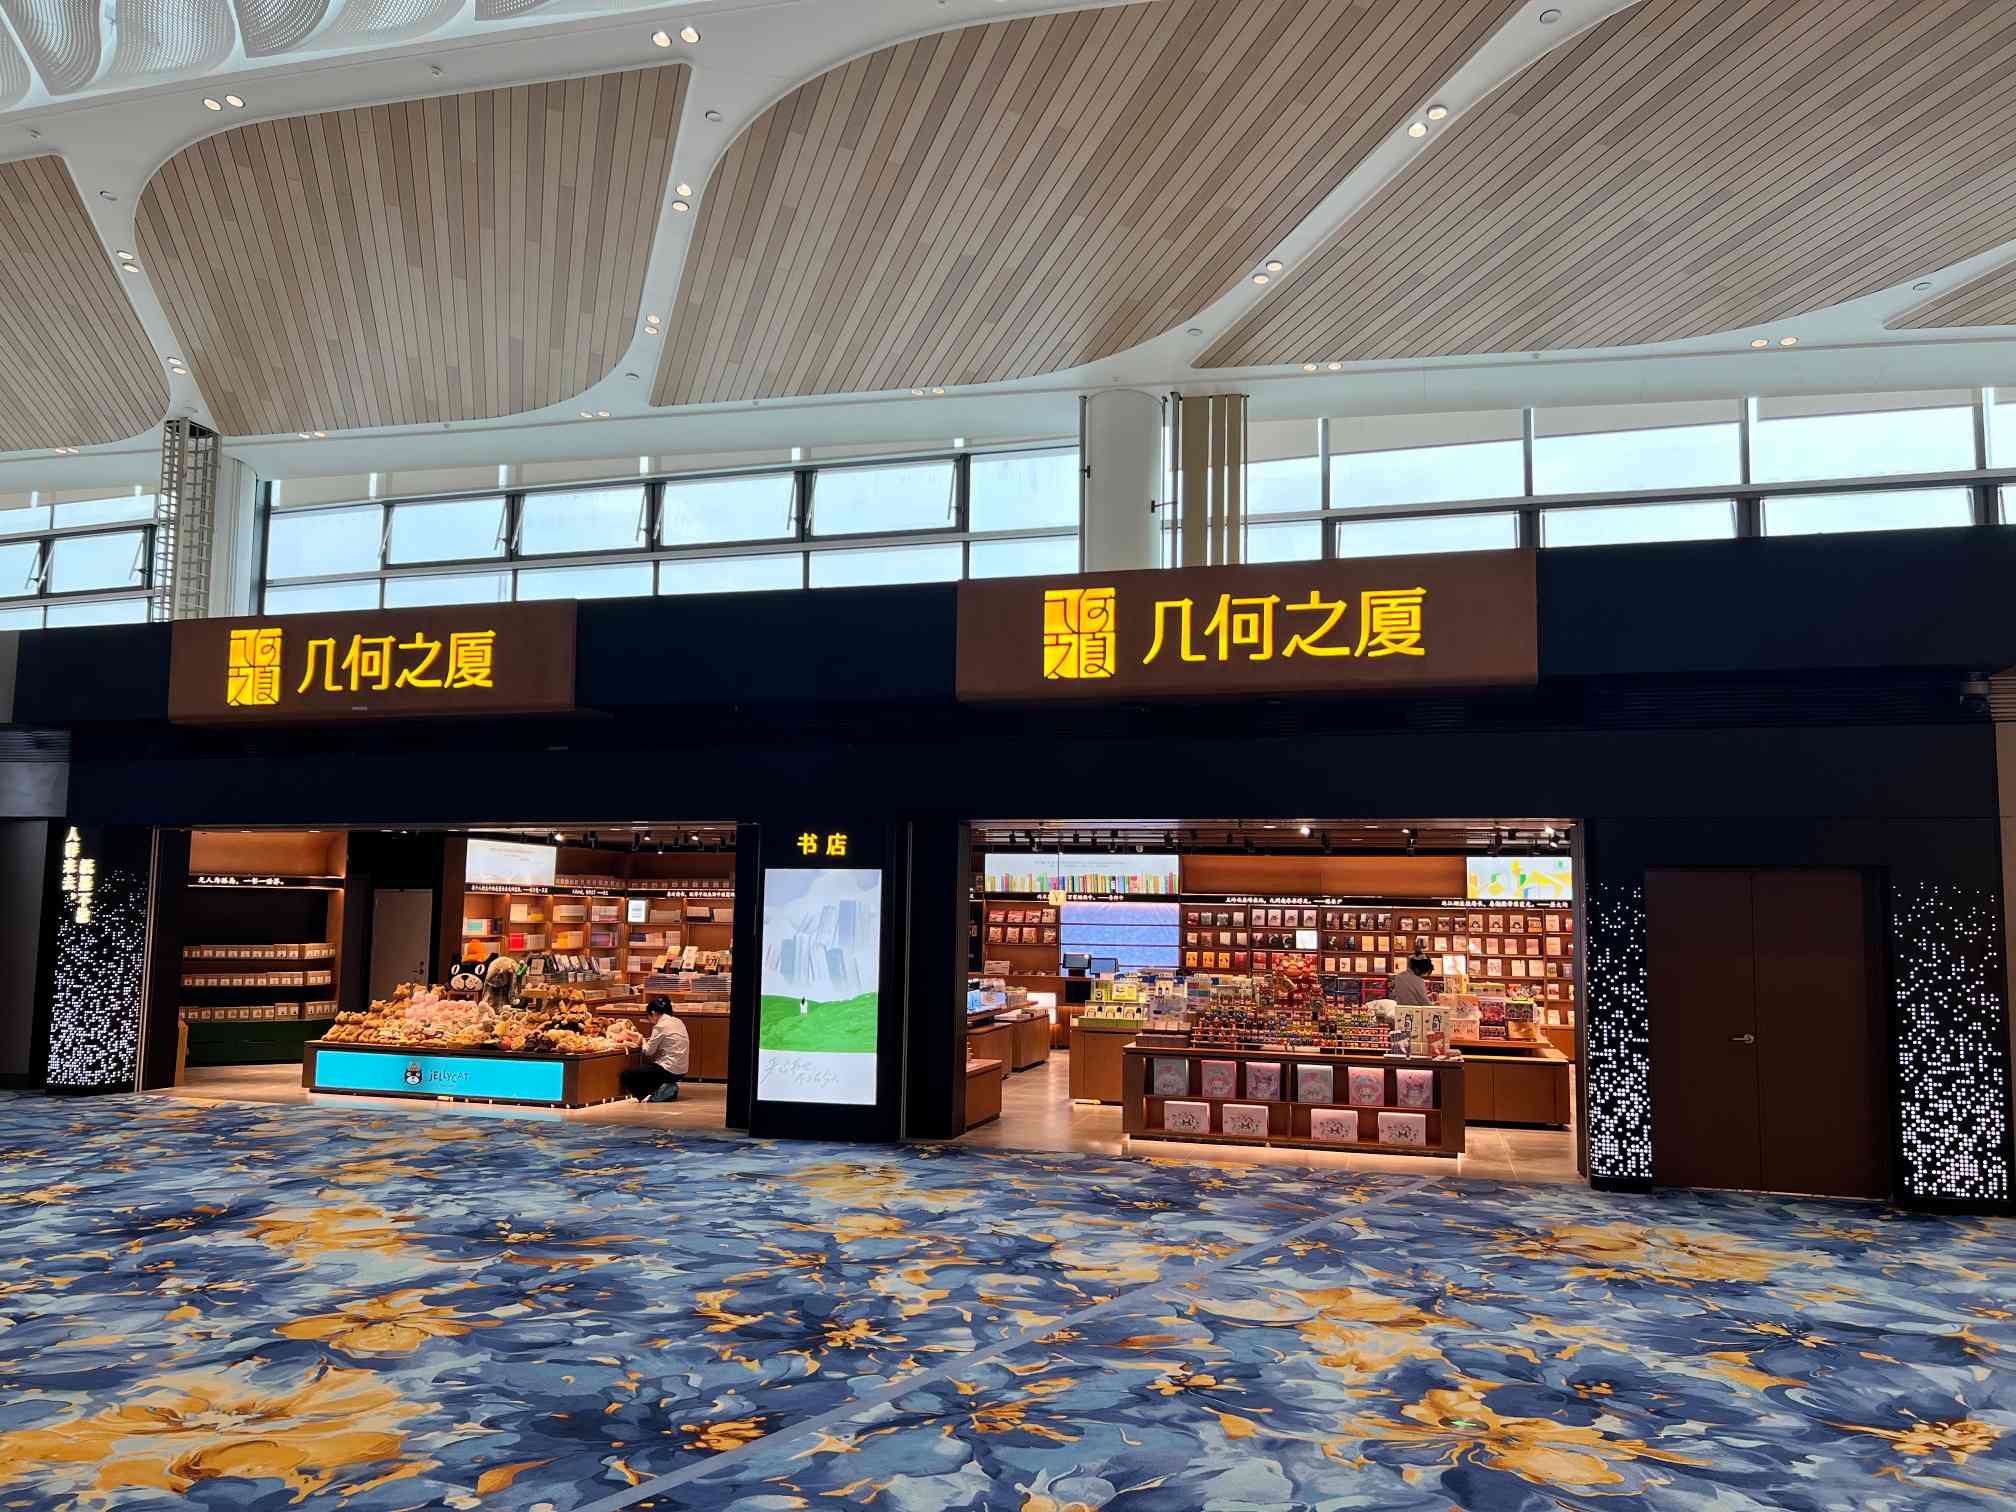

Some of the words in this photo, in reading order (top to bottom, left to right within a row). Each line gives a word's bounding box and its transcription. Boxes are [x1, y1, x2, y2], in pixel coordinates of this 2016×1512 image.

[1142, 586, 1427, 665] 几何之厦
[297, 630, 497, 694] 几何之厦
[797, 832, 848, 856] 书店
